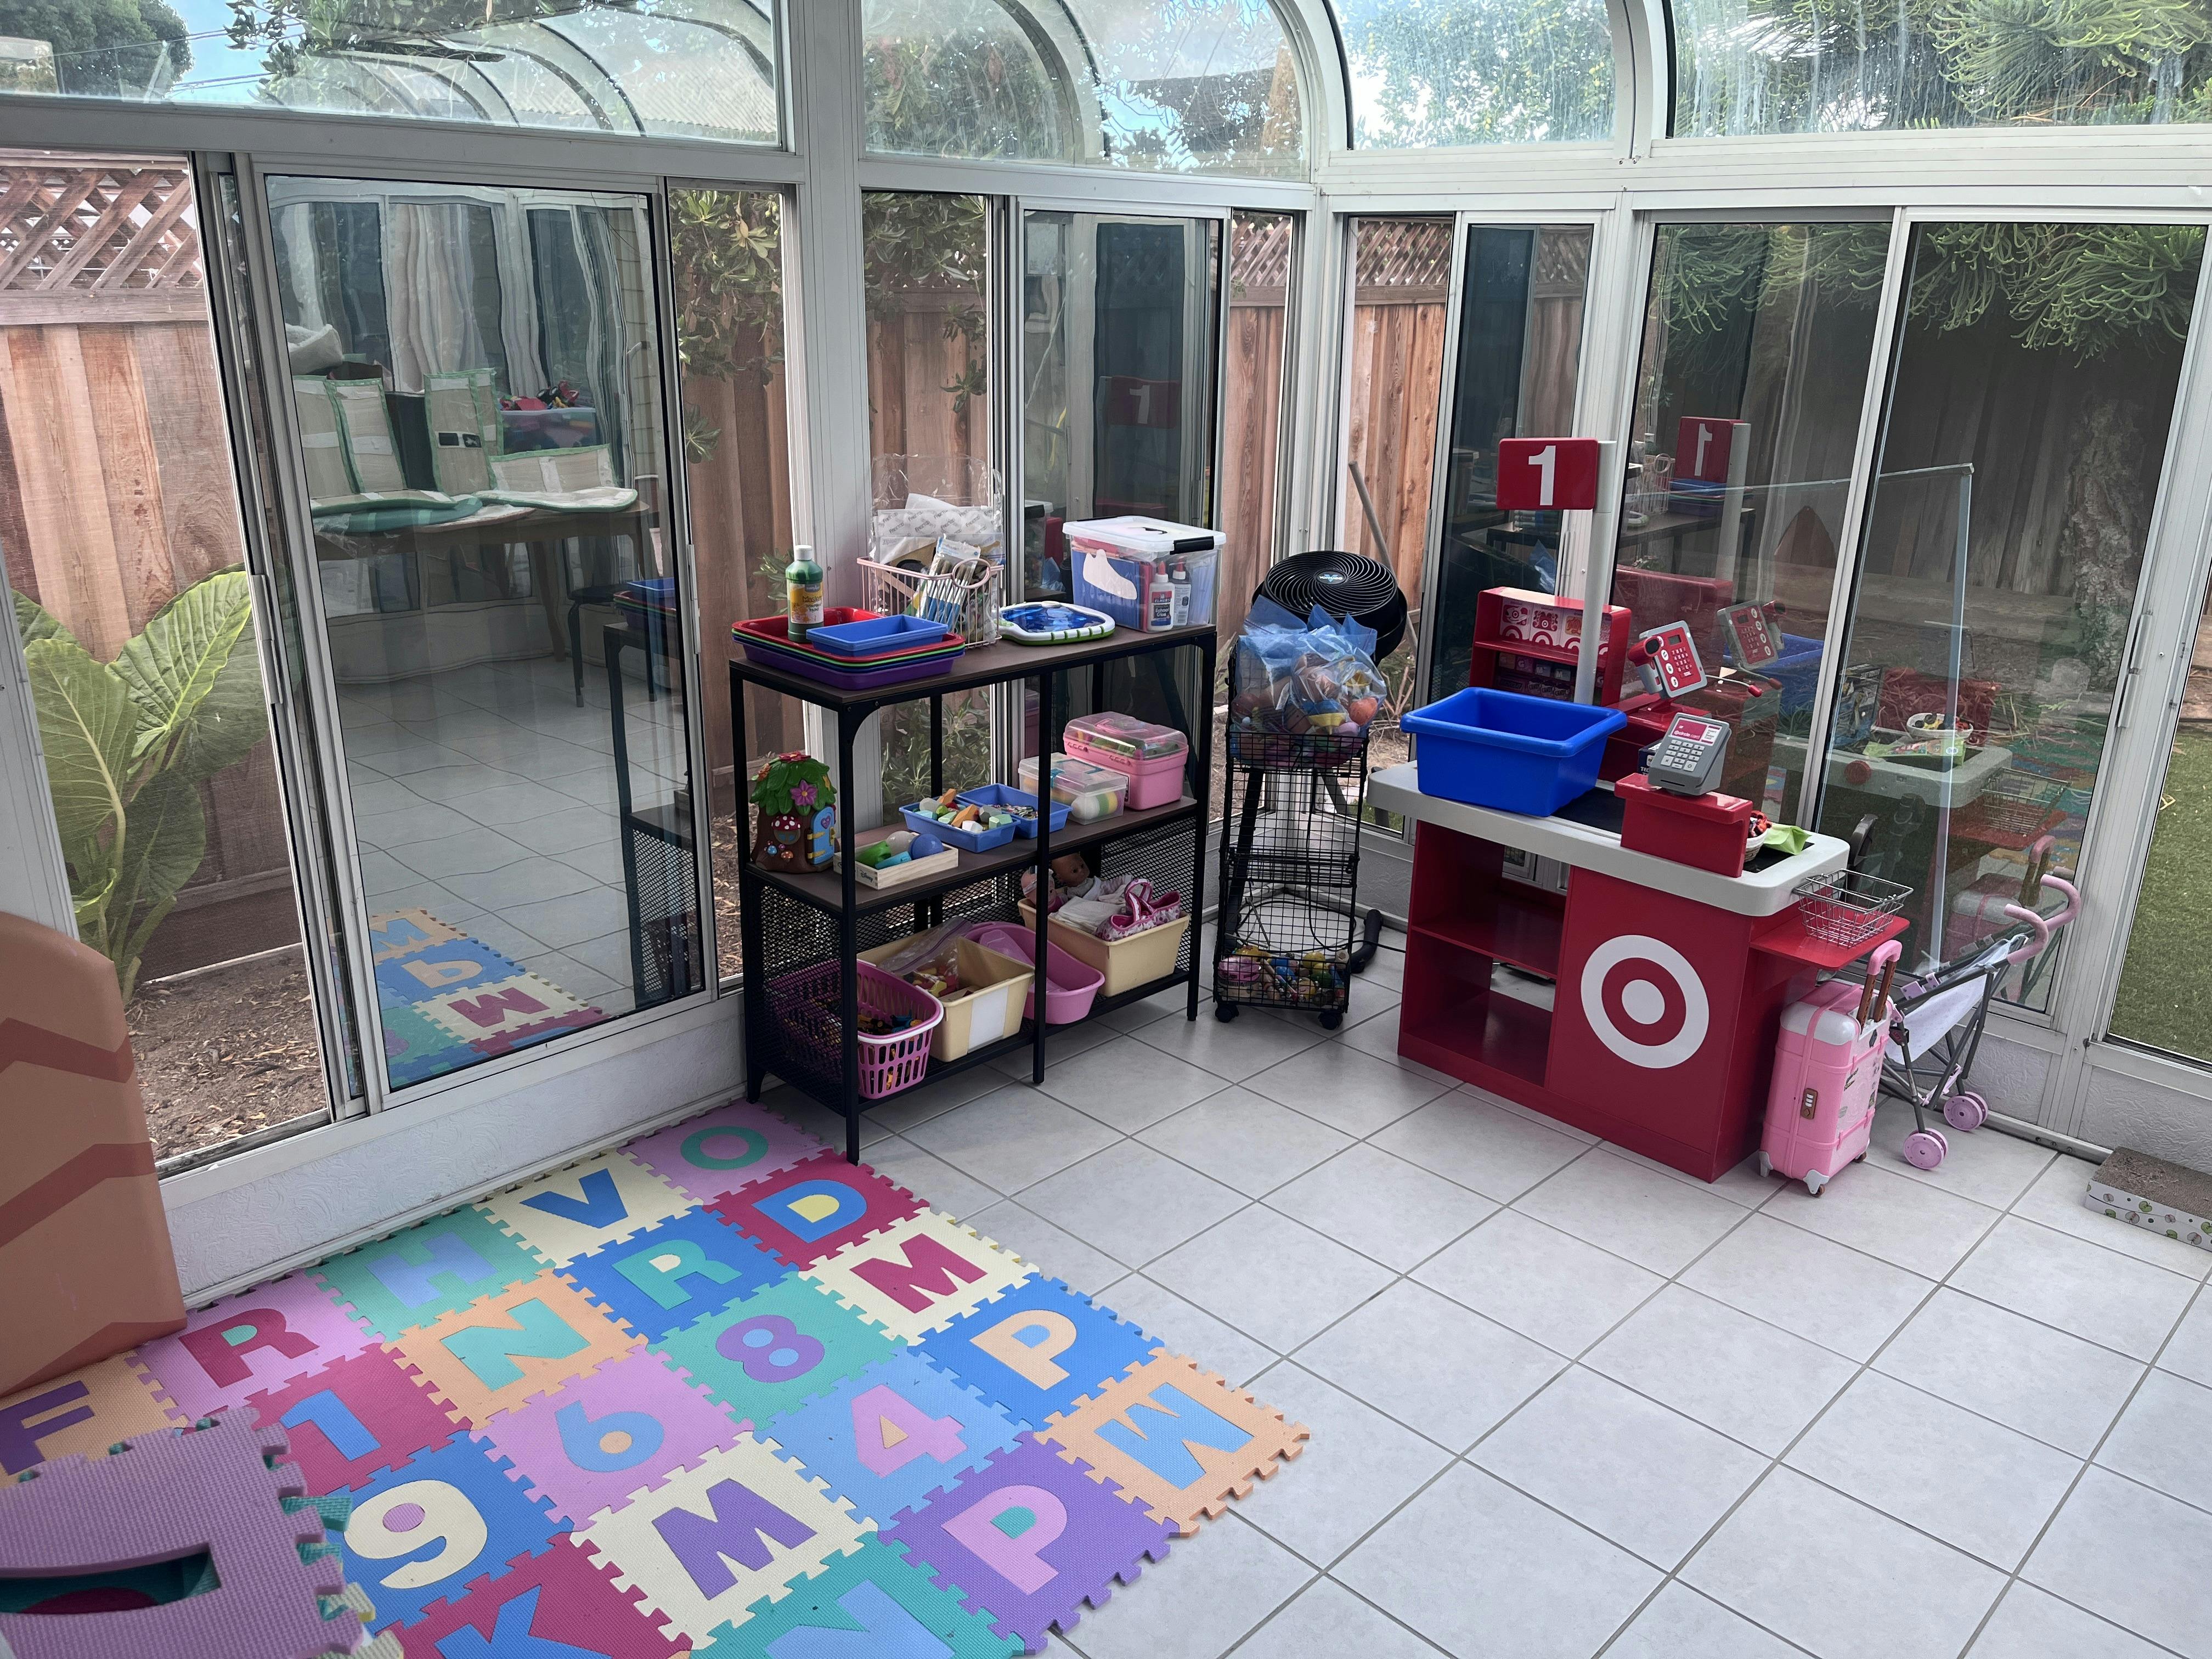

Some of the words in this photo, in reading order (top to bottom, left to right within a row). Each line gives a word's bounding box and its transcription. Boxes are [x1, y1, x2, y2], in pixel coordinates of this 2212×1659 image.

[1130, 385, 1150, 424] 1
[1528, 445, 1556, 505] 1
[680, 1126, 769, 1170] O
[520, 1169, 629, 1228] V
[752, 1180, 867, 1244] D
[367, 1232, 497, 1308] H
[612, 1239, 742, 1311] R
[849, 1233, 989, 1314] M
[179, 1308, 320, 1389] R
[439, 1297, 591, 1392] N
[715, 1314, 825, 1383] 8
[969, 1309, 1077, 1391] P
[280, 1389, 381, 1461] 1
[554, 1400, 664, 1473] 6
[850, 1385, 967, 1479] 4
[344, 1479, 488, 1589] 9
[652, 1477, 818, 1600] M
[941, 1484, 1069, 1595] P
